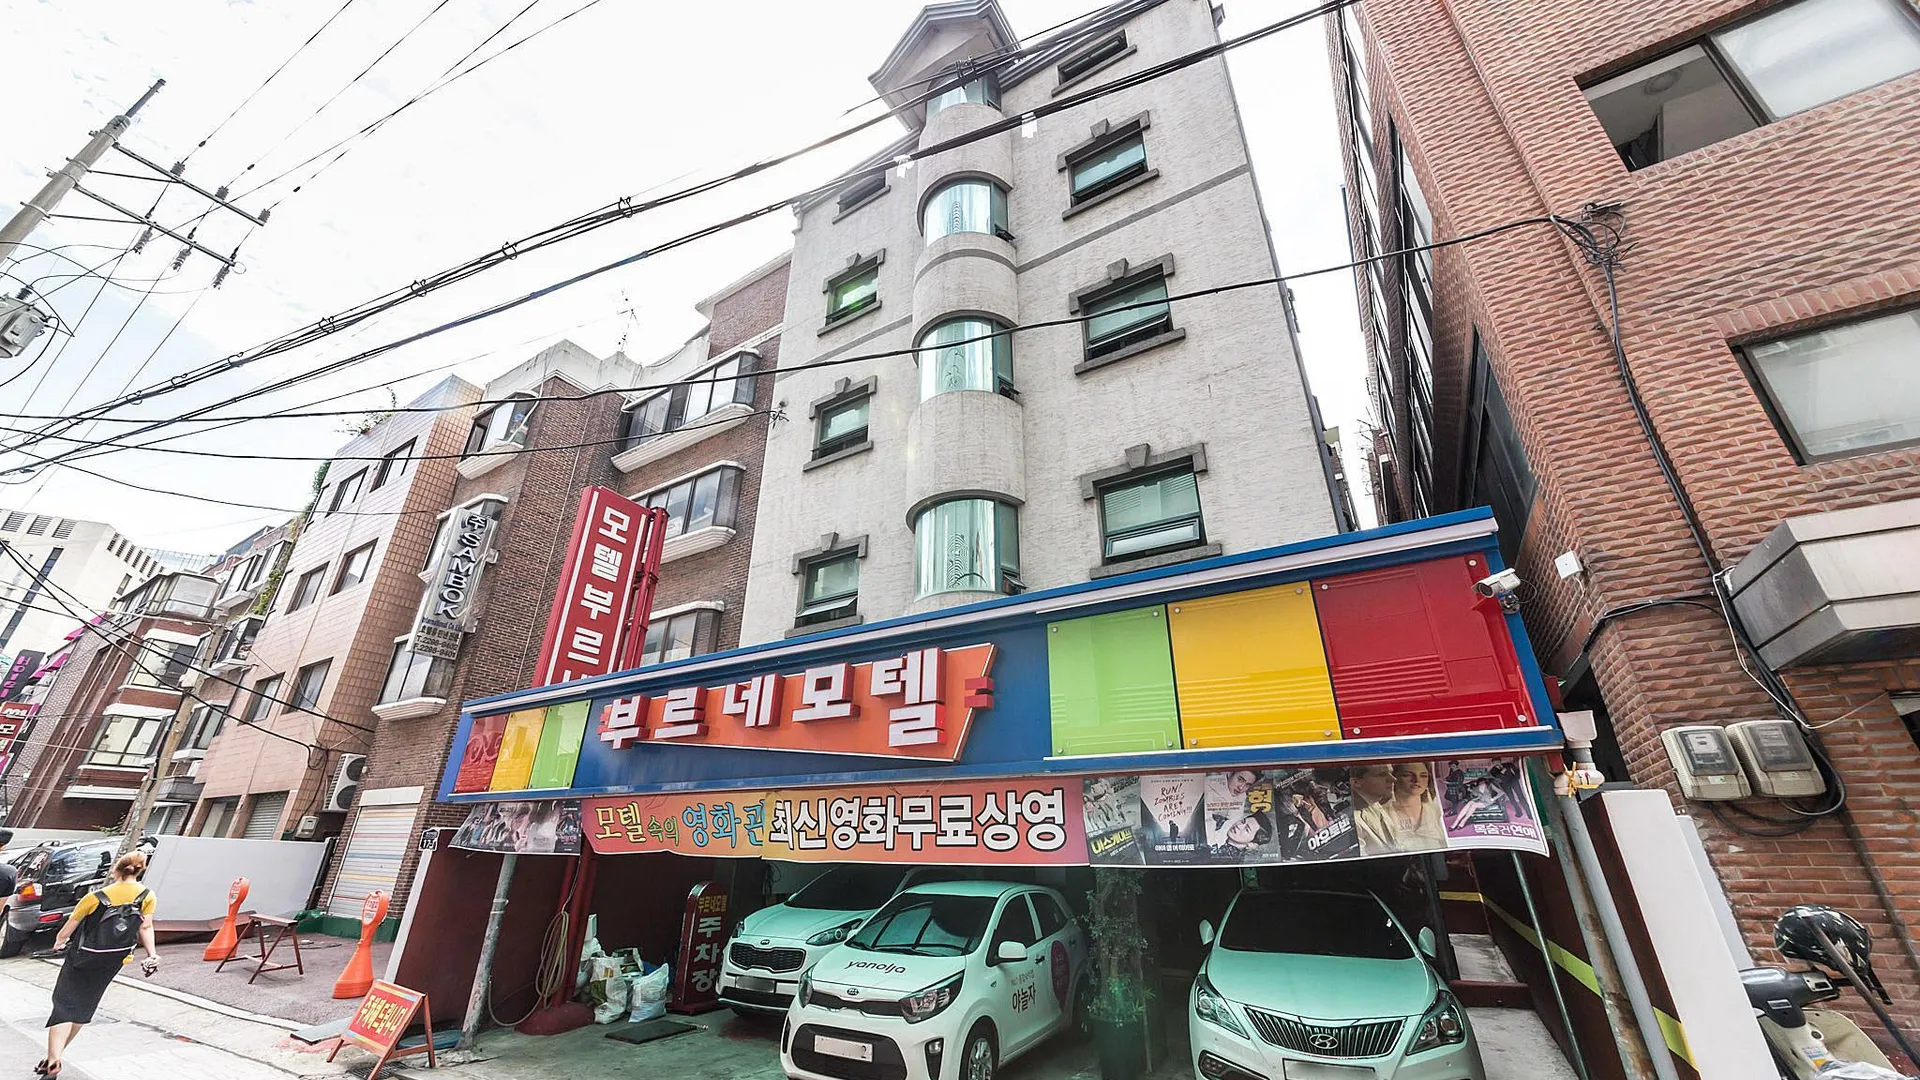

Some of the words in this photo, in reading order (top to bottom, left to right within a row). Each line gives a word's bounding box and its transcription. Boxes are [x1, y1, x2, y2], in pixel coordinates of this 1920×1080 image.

[435, 532, 481, 619] SAMBOK
[1161, 783, 1183, 796] RUN!
[595, 802, 647, 844] 모텔
[648, 815, 680, 846] 속의
[682, 798, 766, 848] 영화관
[691, 915, 722, 993] 주차장
[844, 960, 906, 974] yanolja
[1012, 982, 1036, 1013] 야놀자
